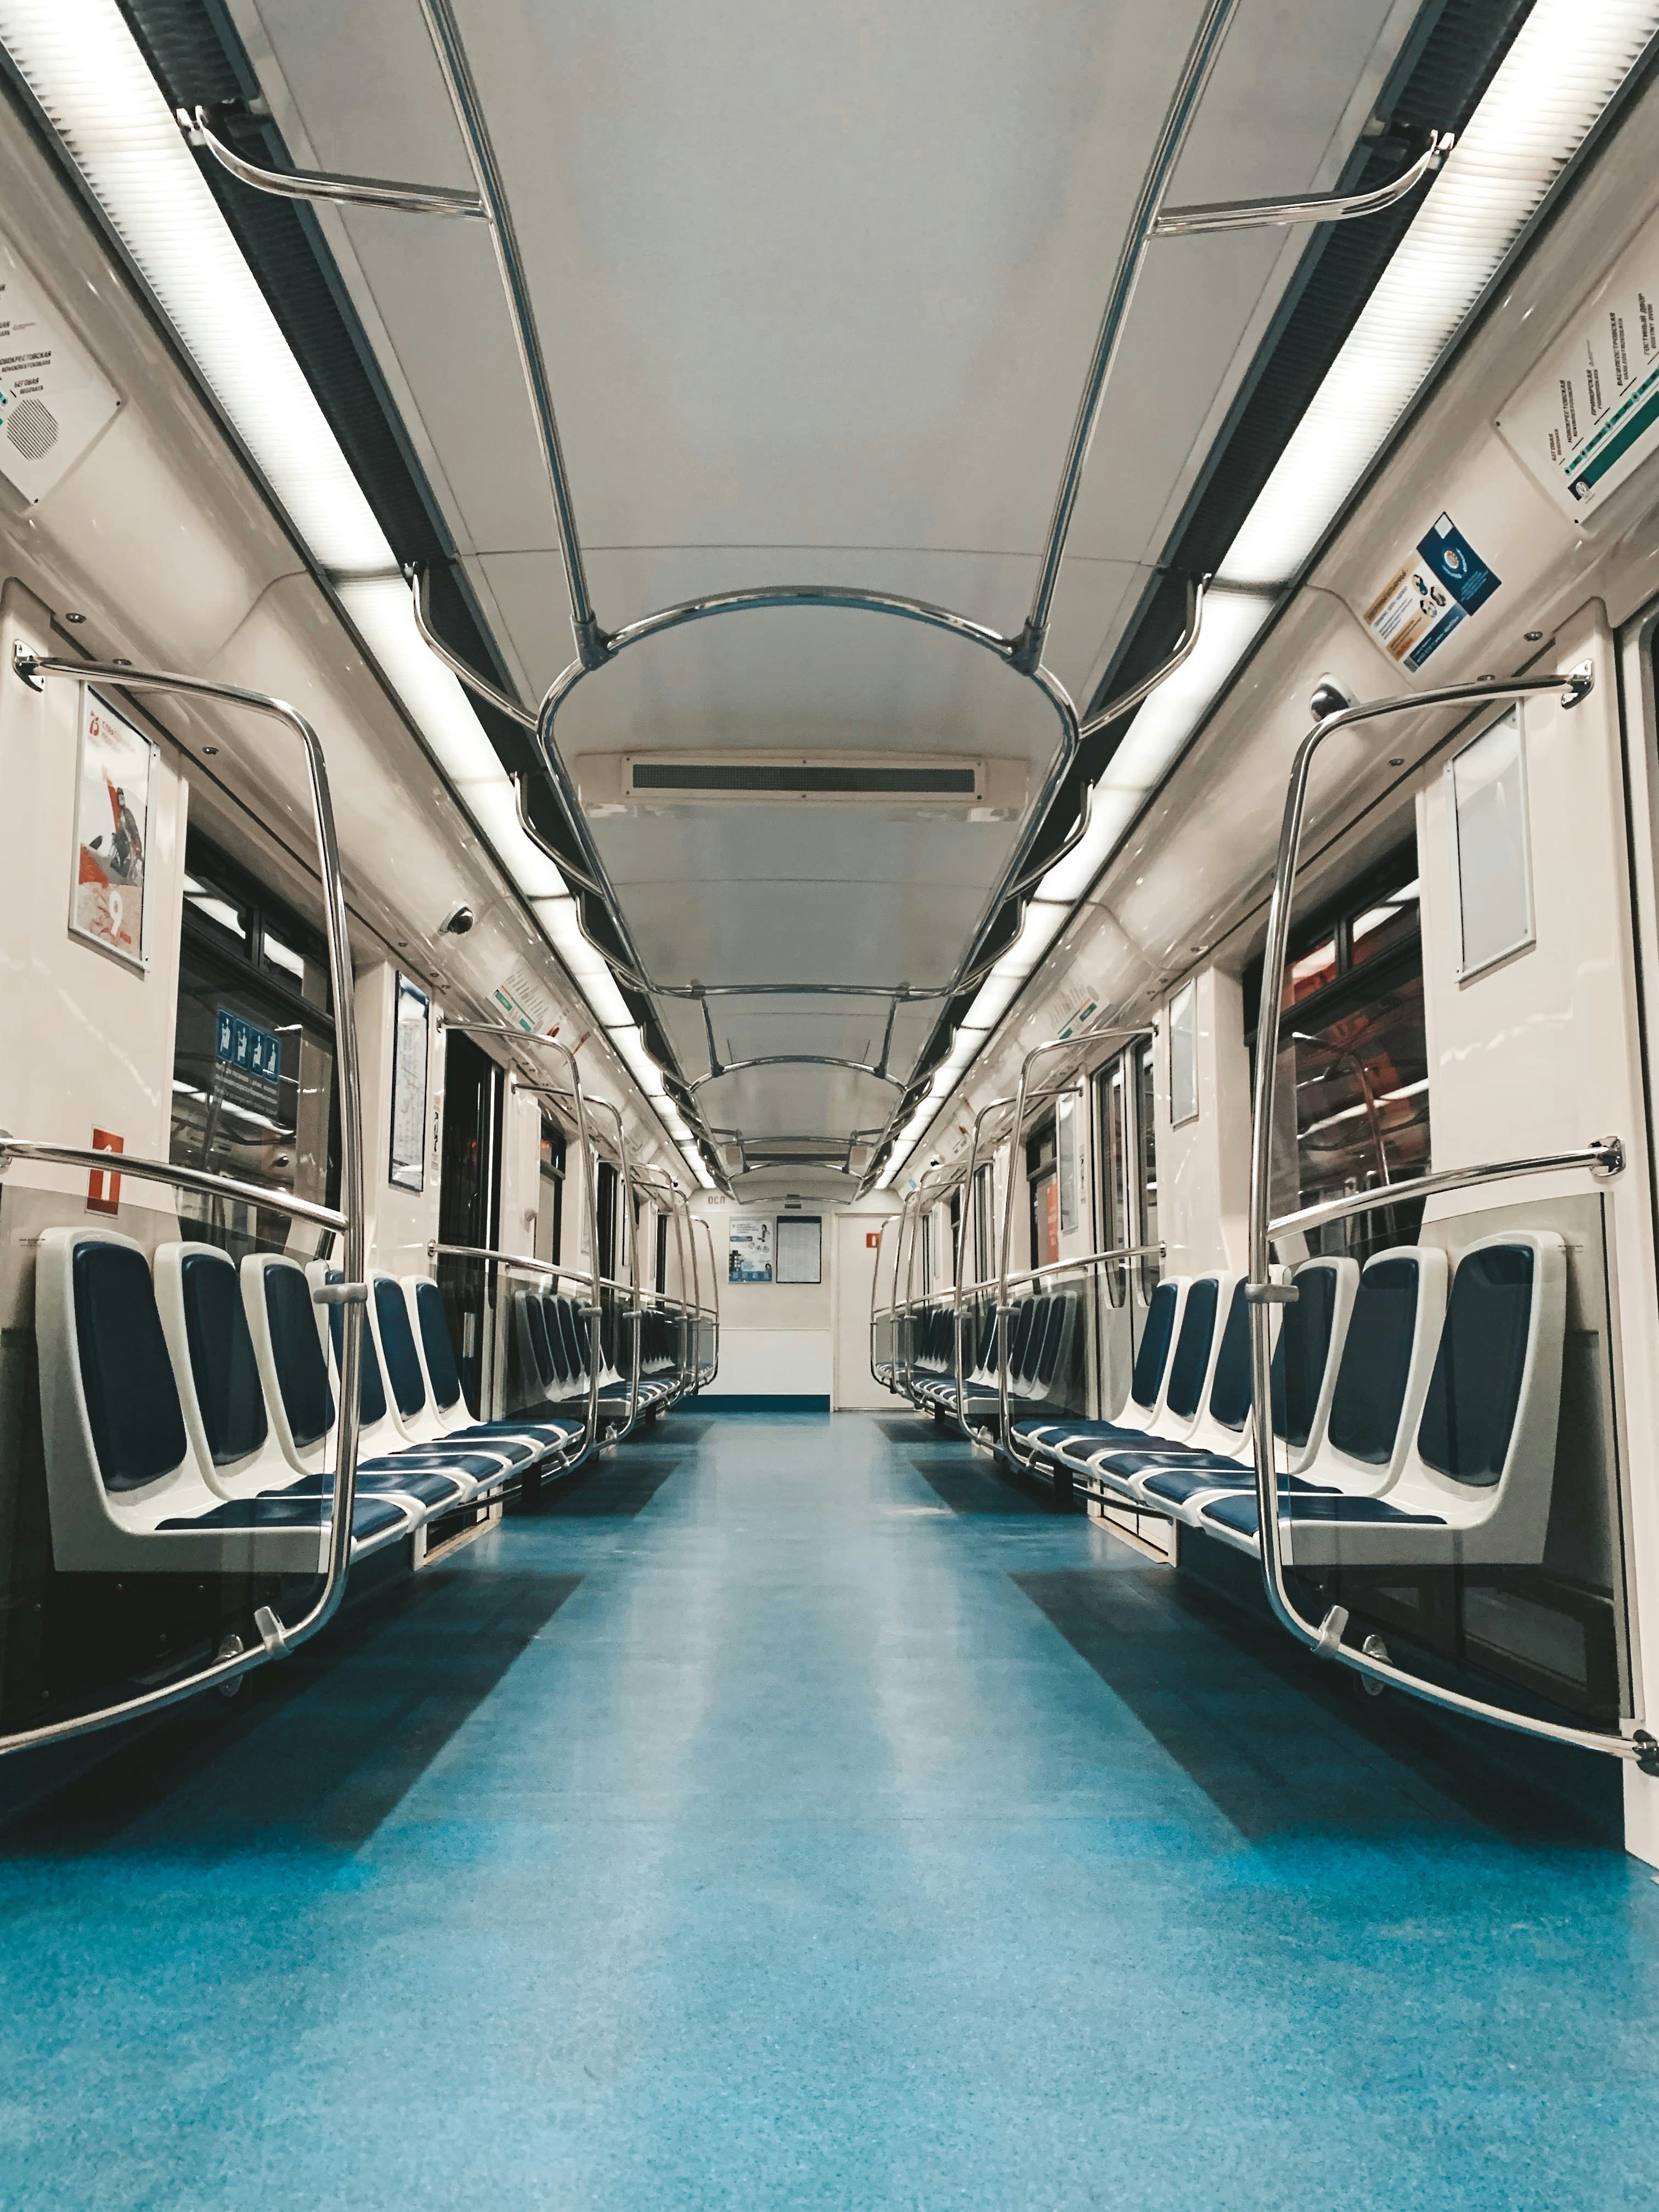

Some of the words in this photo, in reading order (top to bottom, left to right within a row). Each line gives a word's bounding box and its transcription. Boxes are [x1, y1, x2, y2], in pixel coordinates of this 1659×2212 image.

[1609, 312, 1623, 386] ВАСИЛЕОСТРОВСКАЯ
[1586, 369, 1597, 416] ПРИМОРСКАЯ
[109, 890, 123, 937] 9
[708, 1196, 725, 1204] ОСП
